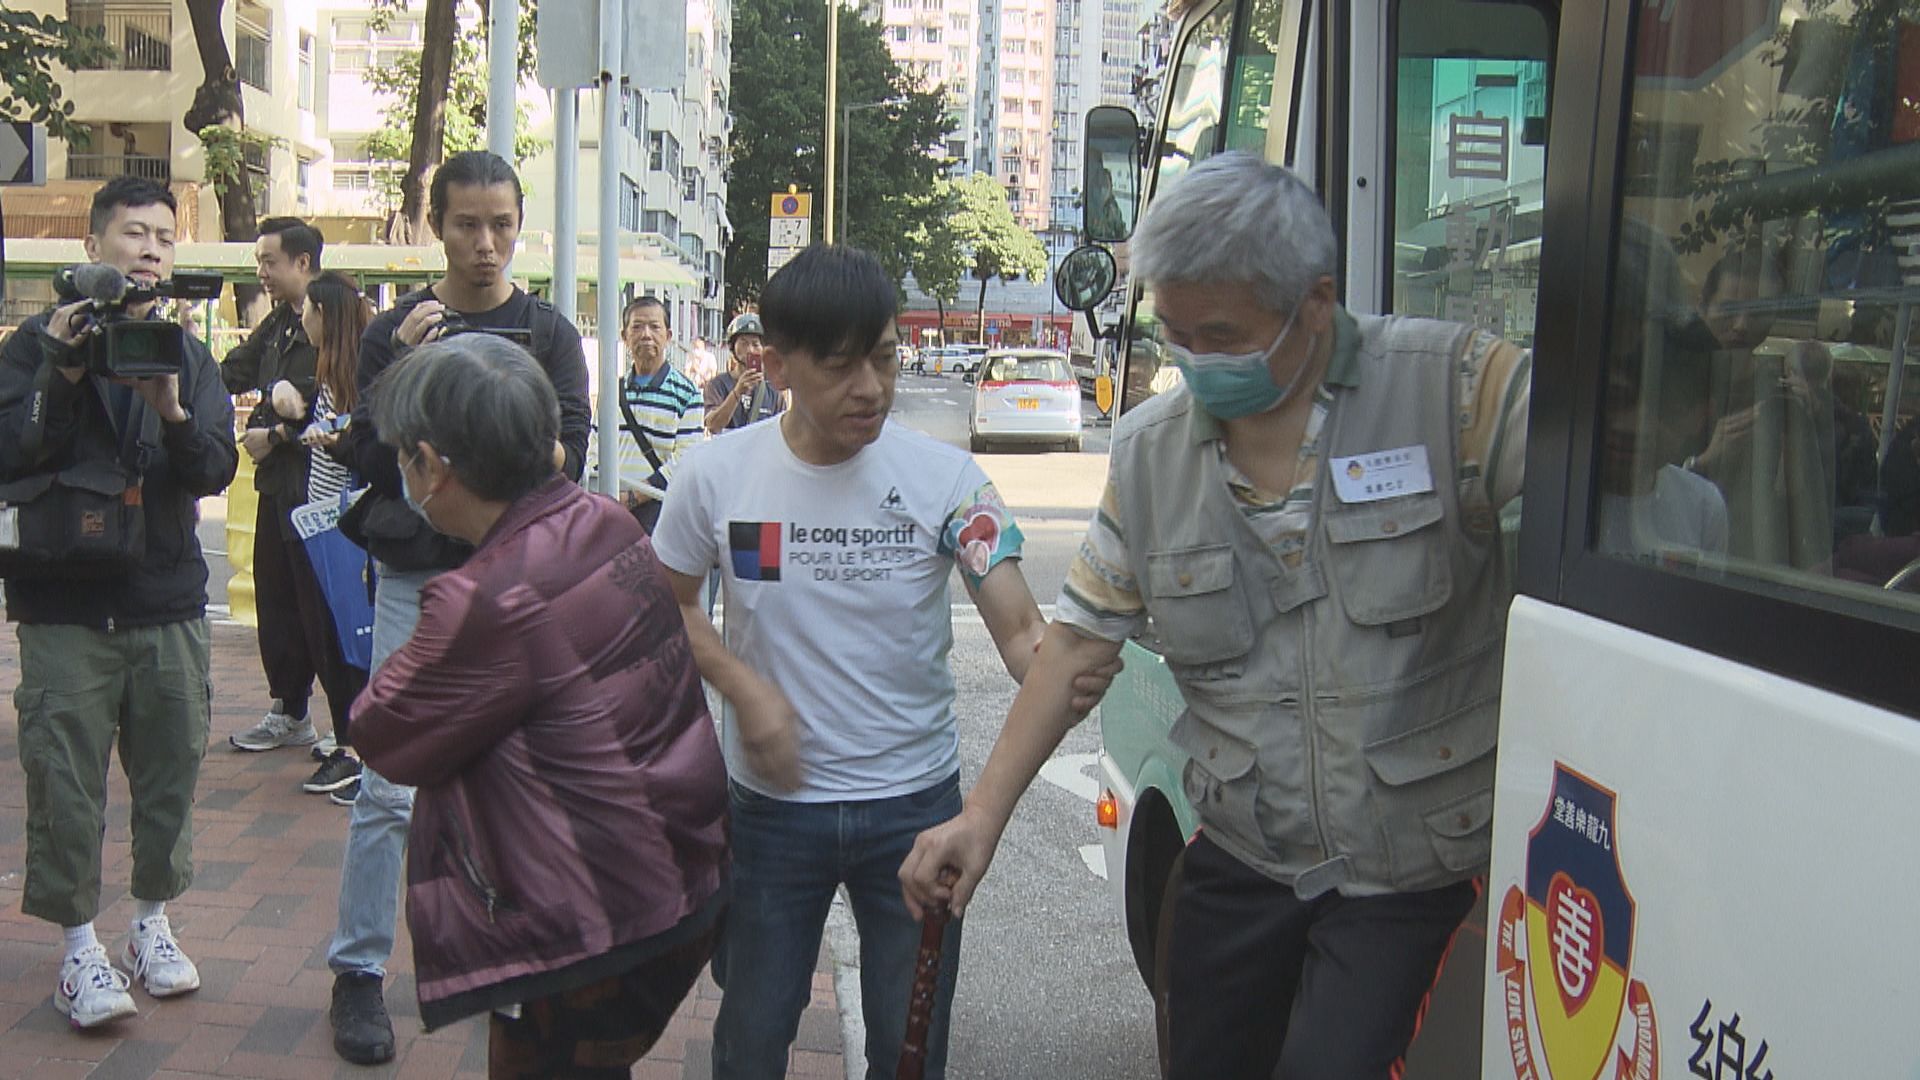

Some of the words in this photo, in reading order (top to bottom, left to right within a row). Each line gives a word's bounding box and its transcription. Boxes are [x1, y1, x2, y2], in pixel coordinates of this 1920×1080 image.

[790, 522, 807, 544] le
[811, 527, 847, 547] coq
[851, 524, 915, 547] sportif
[789, 552, 831, 565] POUR
[837, 552, 856, 565] LE
[861, 550, 915, 565] PLAISR
[815, 568, 837, 582] DU
[842, 568, 892, 582] SPORT
[1502, 919, 1513, 951] THE
[1507, 979, 1523, 1021] LOK
[1633, 1002, 1652, 1080] OWLOON
